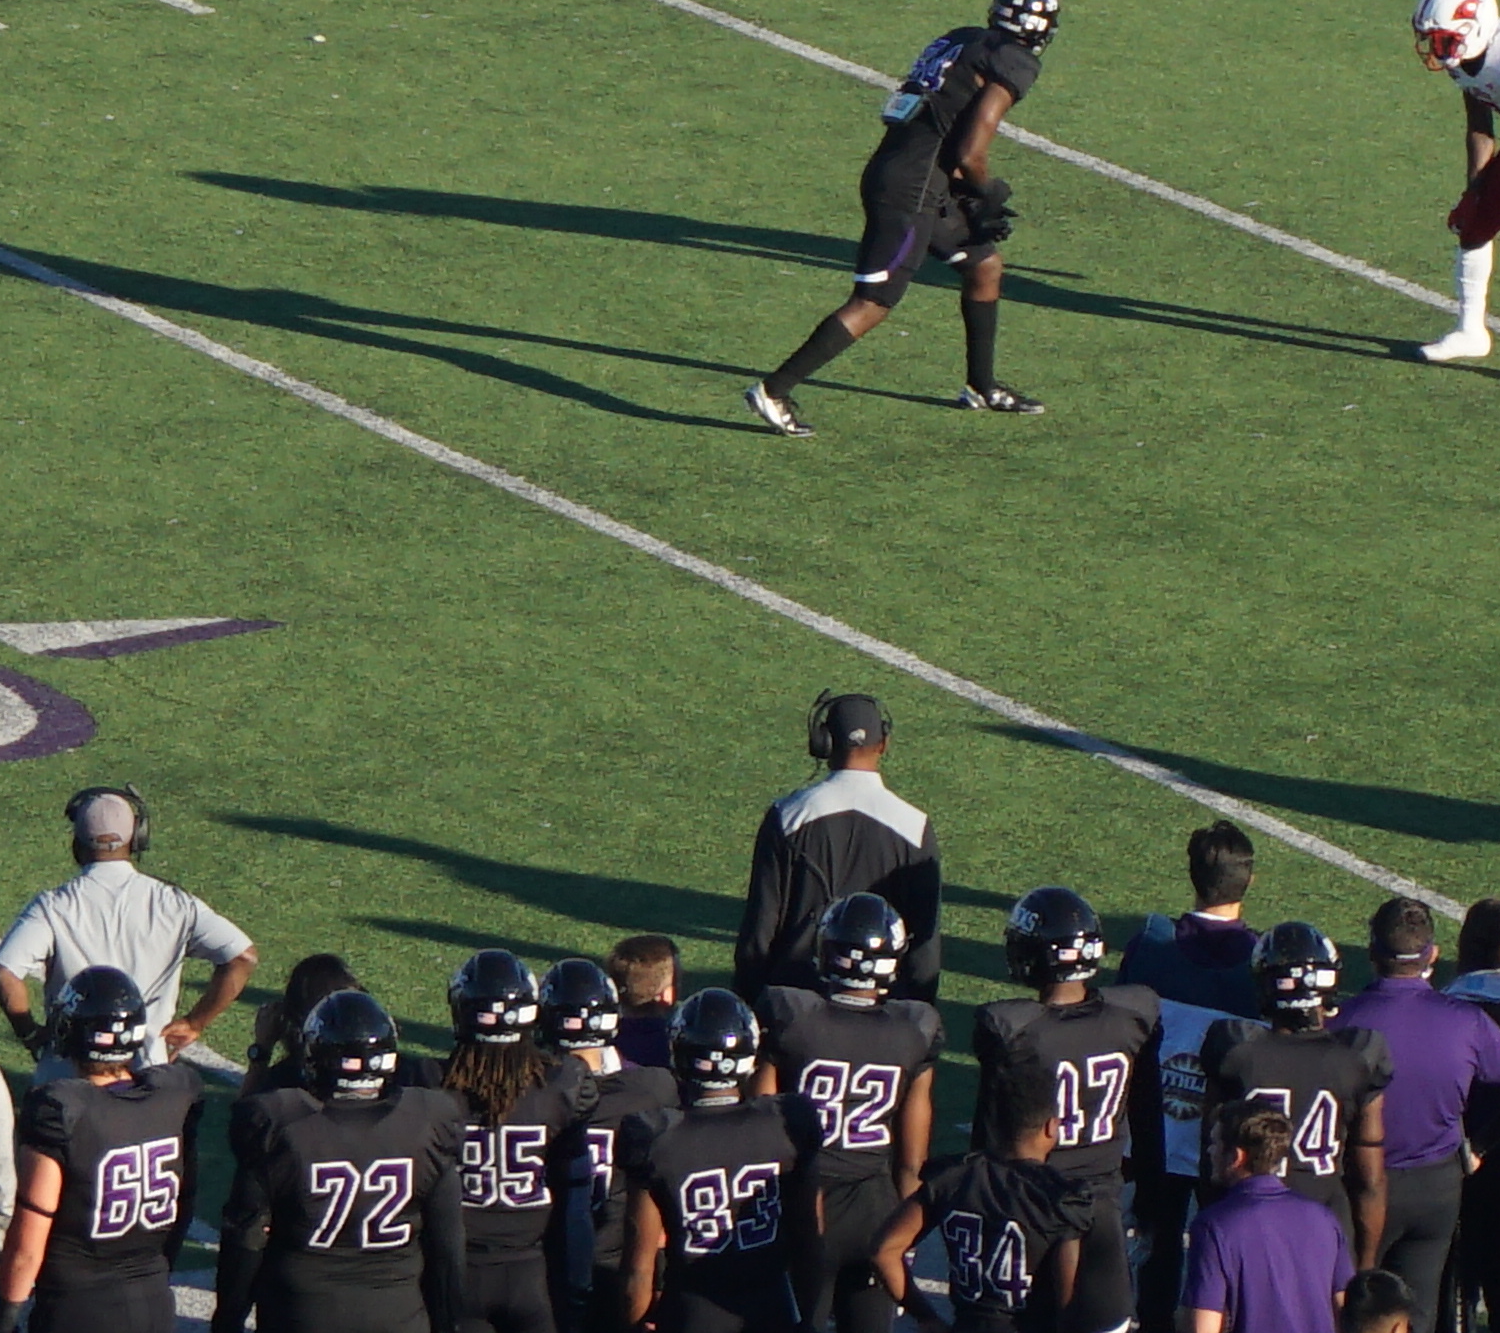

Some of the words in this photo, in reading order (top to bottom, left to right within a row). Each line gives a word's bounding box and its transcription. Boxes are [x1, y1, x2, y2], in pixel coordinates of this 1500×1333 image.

[91, 1136, 180, 1239] 65
[310, 1156, 413, 1250] 72
[462, 1124, 553, 1208] 85
[680, 1161, 782, 1255] 83
[943, 1209, 1032, 1309] 34
